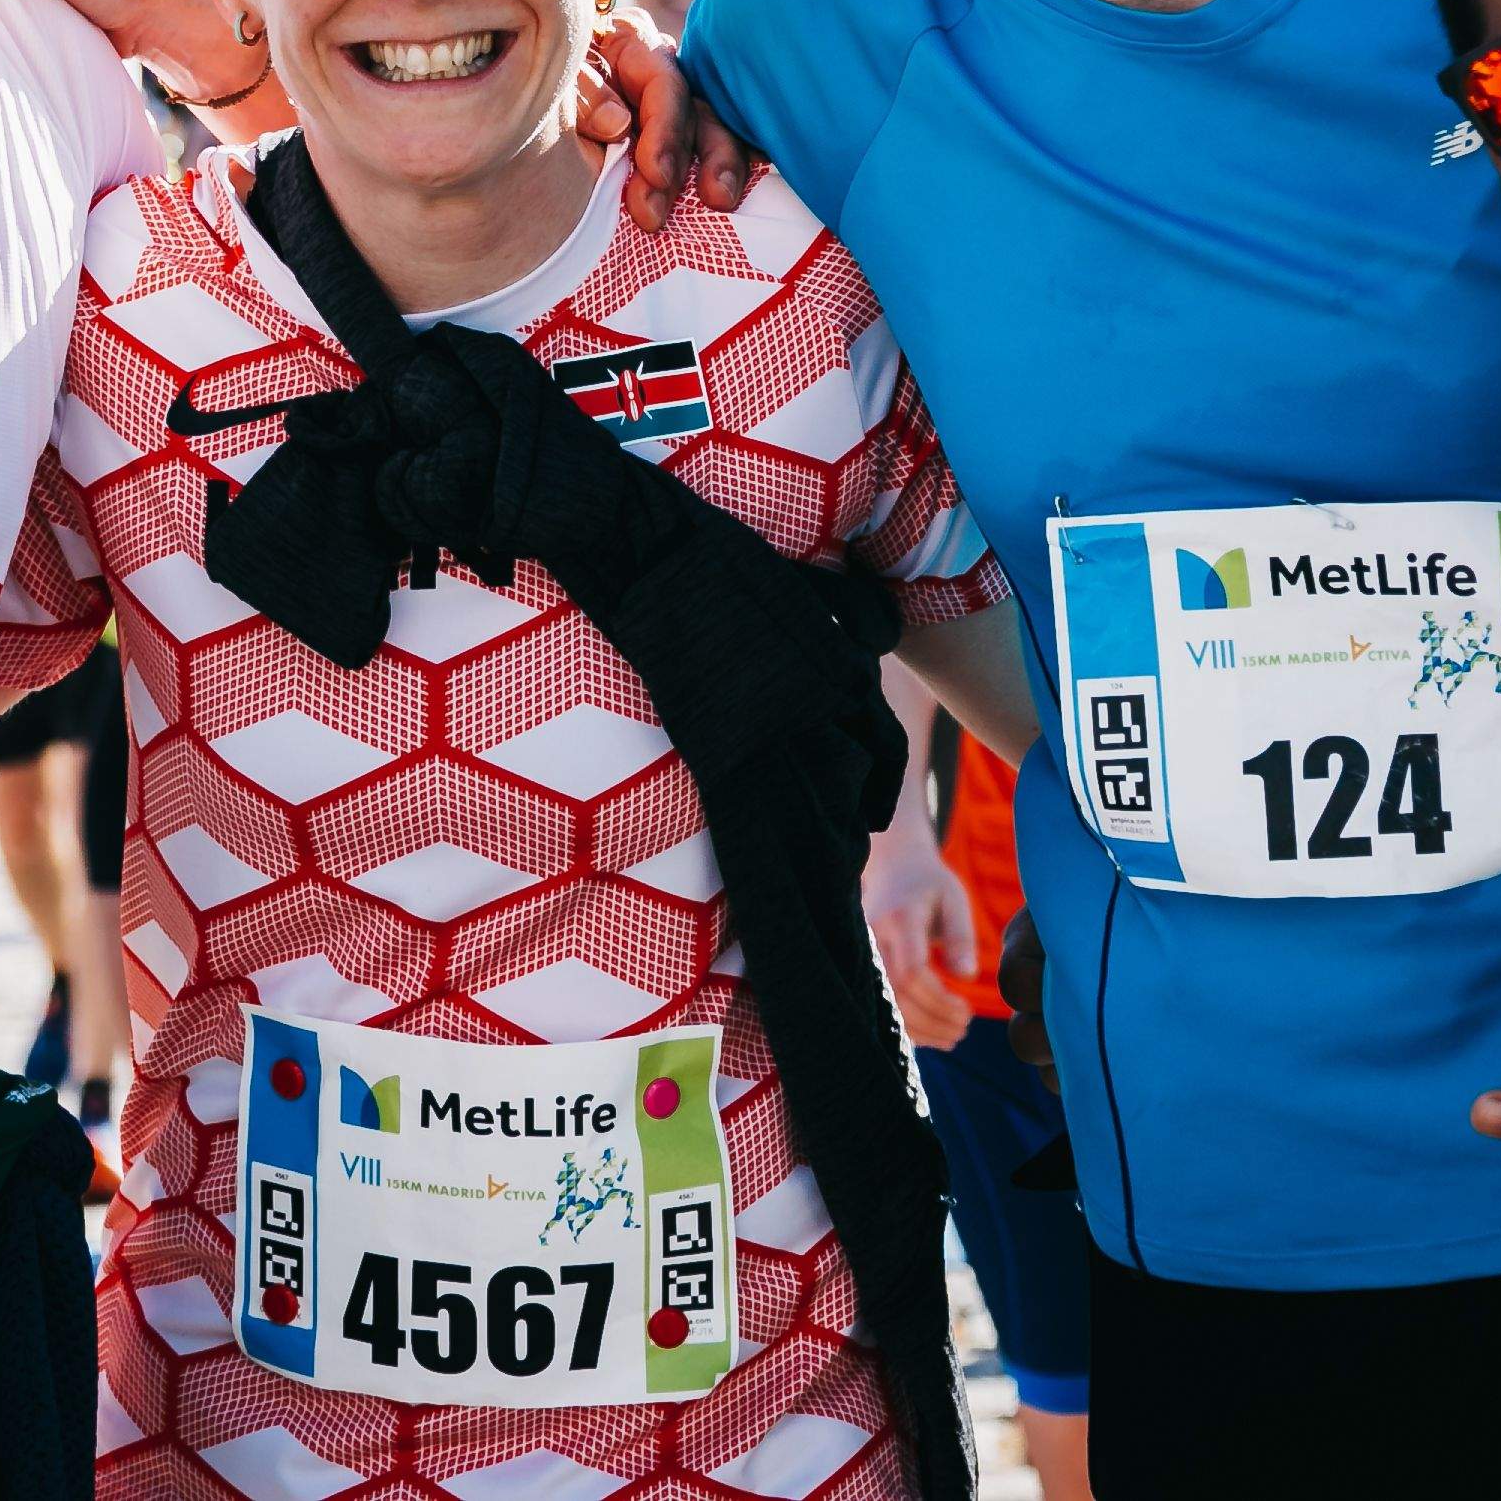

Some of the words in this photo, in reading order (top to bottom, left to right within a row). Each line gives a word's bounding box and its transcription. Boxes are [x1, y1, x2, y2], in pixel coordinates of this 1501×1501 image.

[1269, 552, 1477, 597] MetLife
[1185, 639, 1235, 669] VIII
[1241, 655, 1281, 667] 15KM
[1288, 651, 1348, 665] MADRID
[1242, 733, 1452, 862] 124
[420, 1088, 617, 1138] MetLife
[340, 1151, 381, 1187] VIII
[386, 1178, 422, 1193] 15KM
[427, 1184, 485, 1199] MADRID
[342, 1251, 616, 1378] 4567
